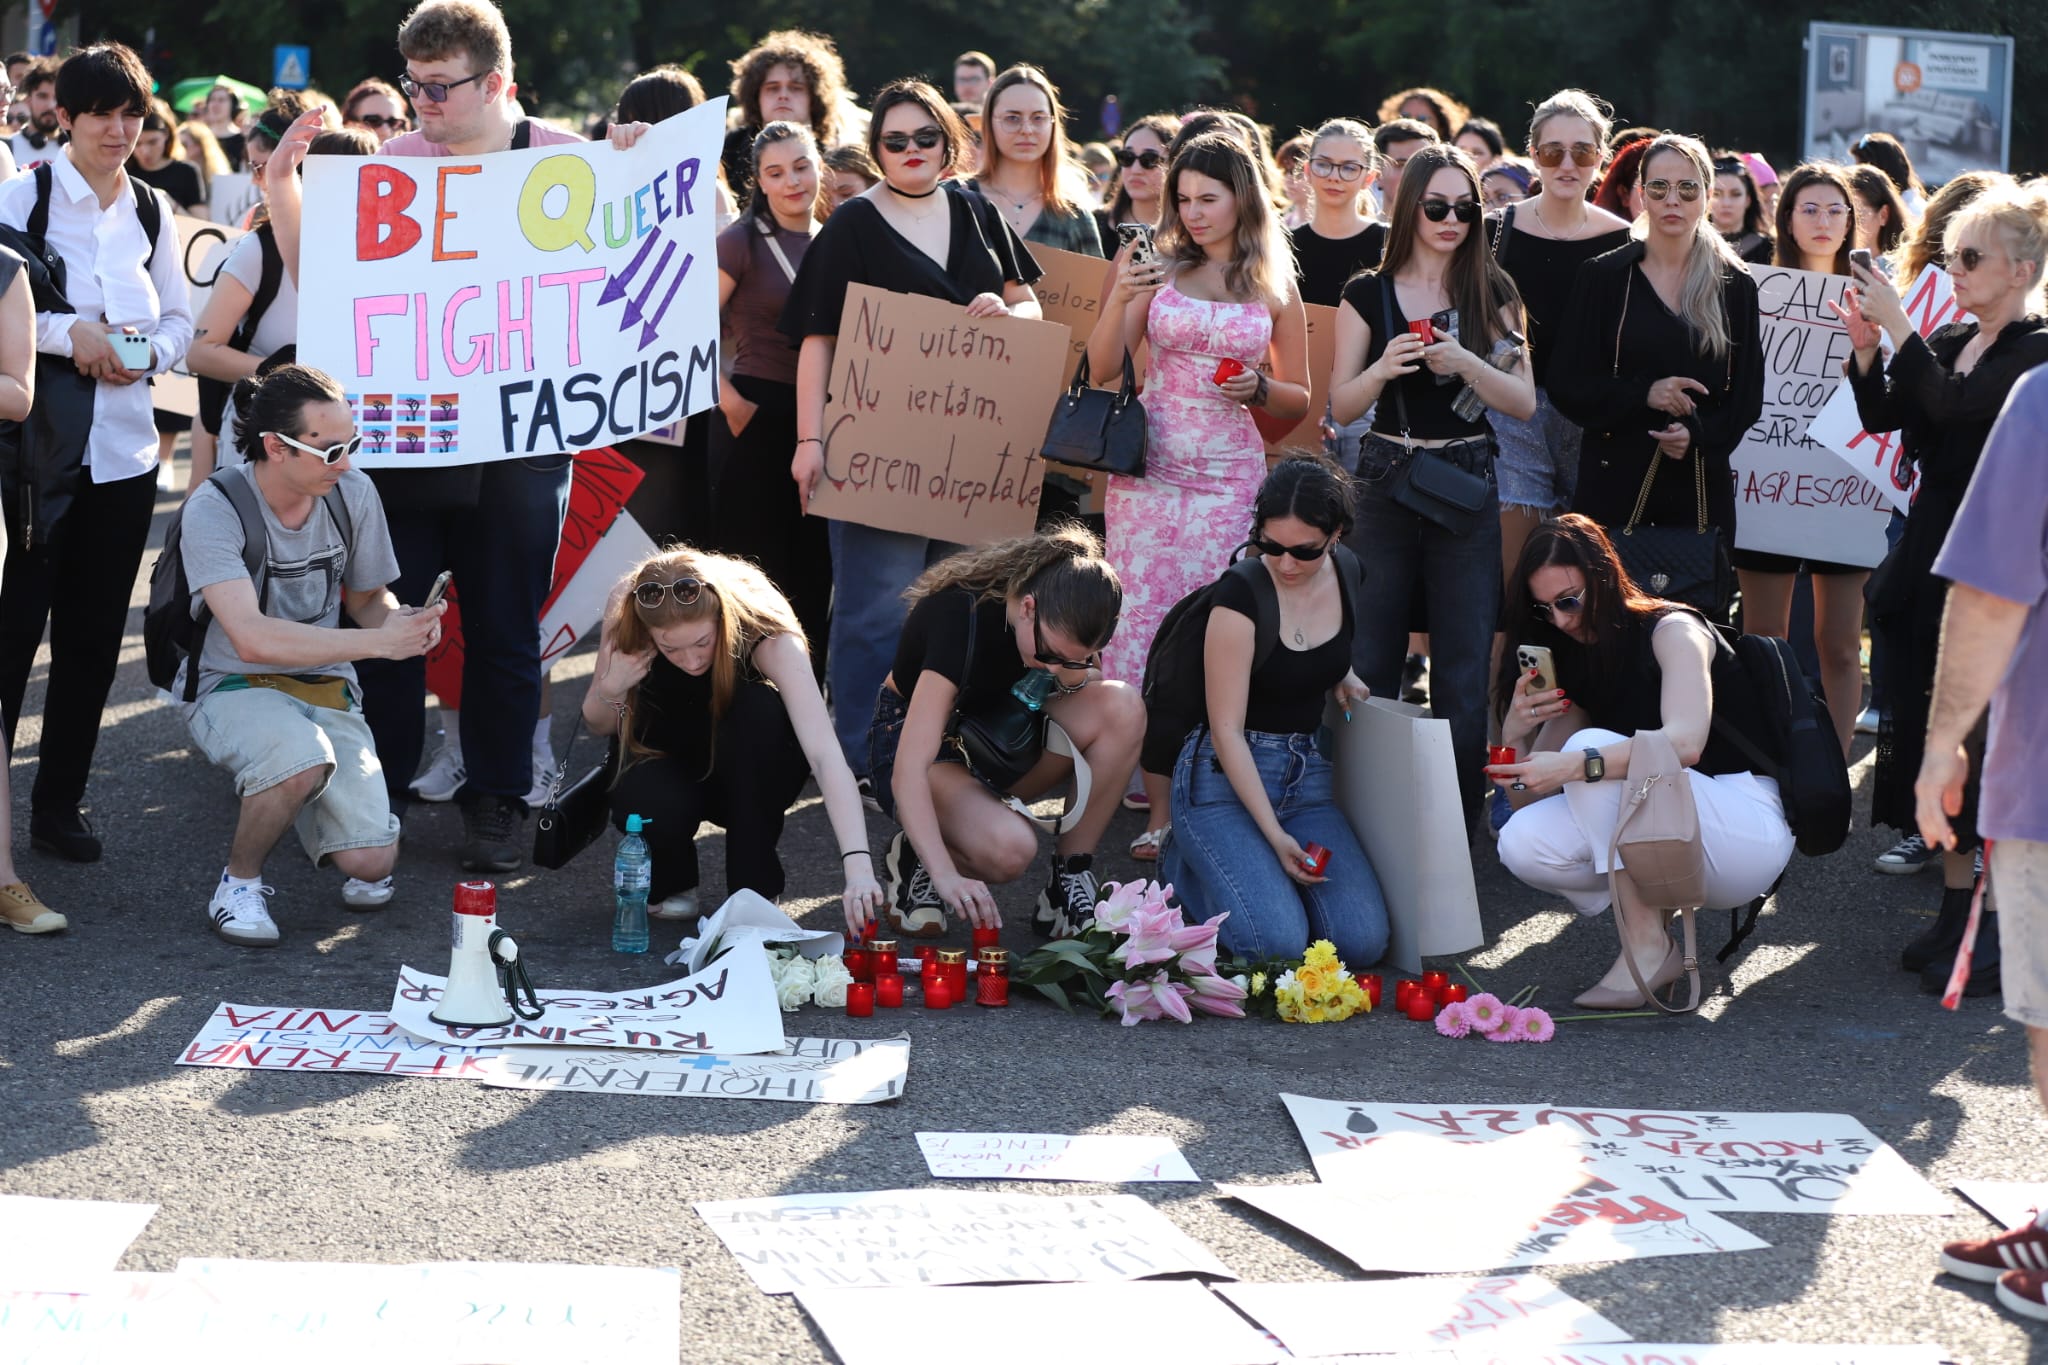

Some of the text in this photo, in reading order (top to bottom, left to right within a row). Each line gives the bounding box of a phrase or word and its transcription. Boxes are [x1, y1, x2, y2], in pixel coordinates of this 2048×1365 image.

[356, 163, 482, 262] BE
[517, 154, 700, 253] QUEER
[353, 266, 607, 381] FIGHT
[854, 297, 1011, 363] Nu uităm.
[500, 339, 719, 453] FASCISM
[842, 358, 1003, 425] Nu iertăm.
[824, 414, 1040, 518] Cerem dreptate
